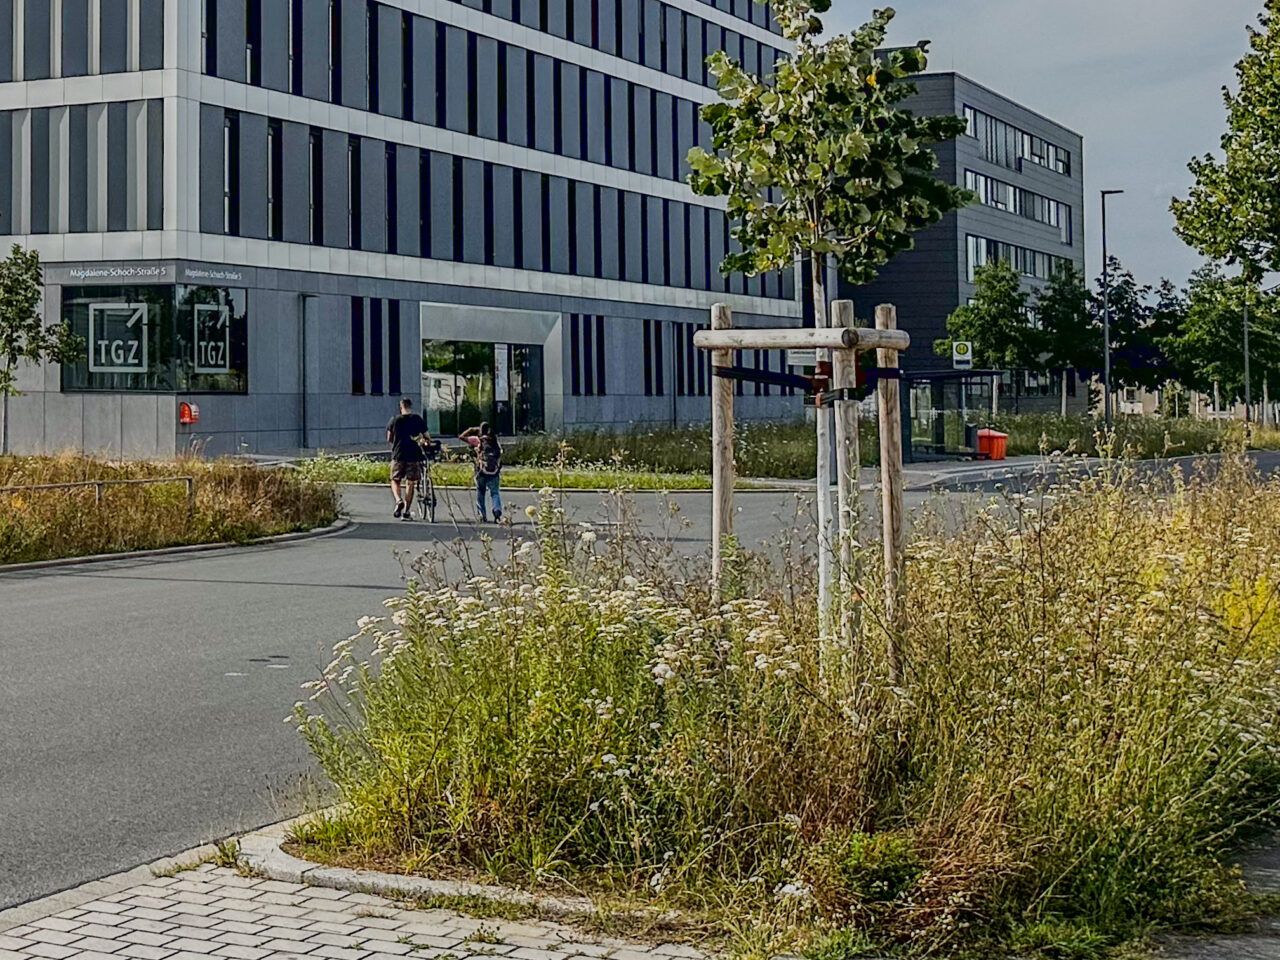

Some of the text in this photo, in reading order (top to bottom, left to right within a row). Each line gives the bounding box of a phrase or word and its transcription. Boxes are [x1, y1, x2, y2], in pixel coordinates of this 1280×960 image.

[70, 266, 166, 279] Magdalene-Schoch-Straße 5
[97, 340, 139, 364] TGZ
[199, 341, 225, 365] TGZ
